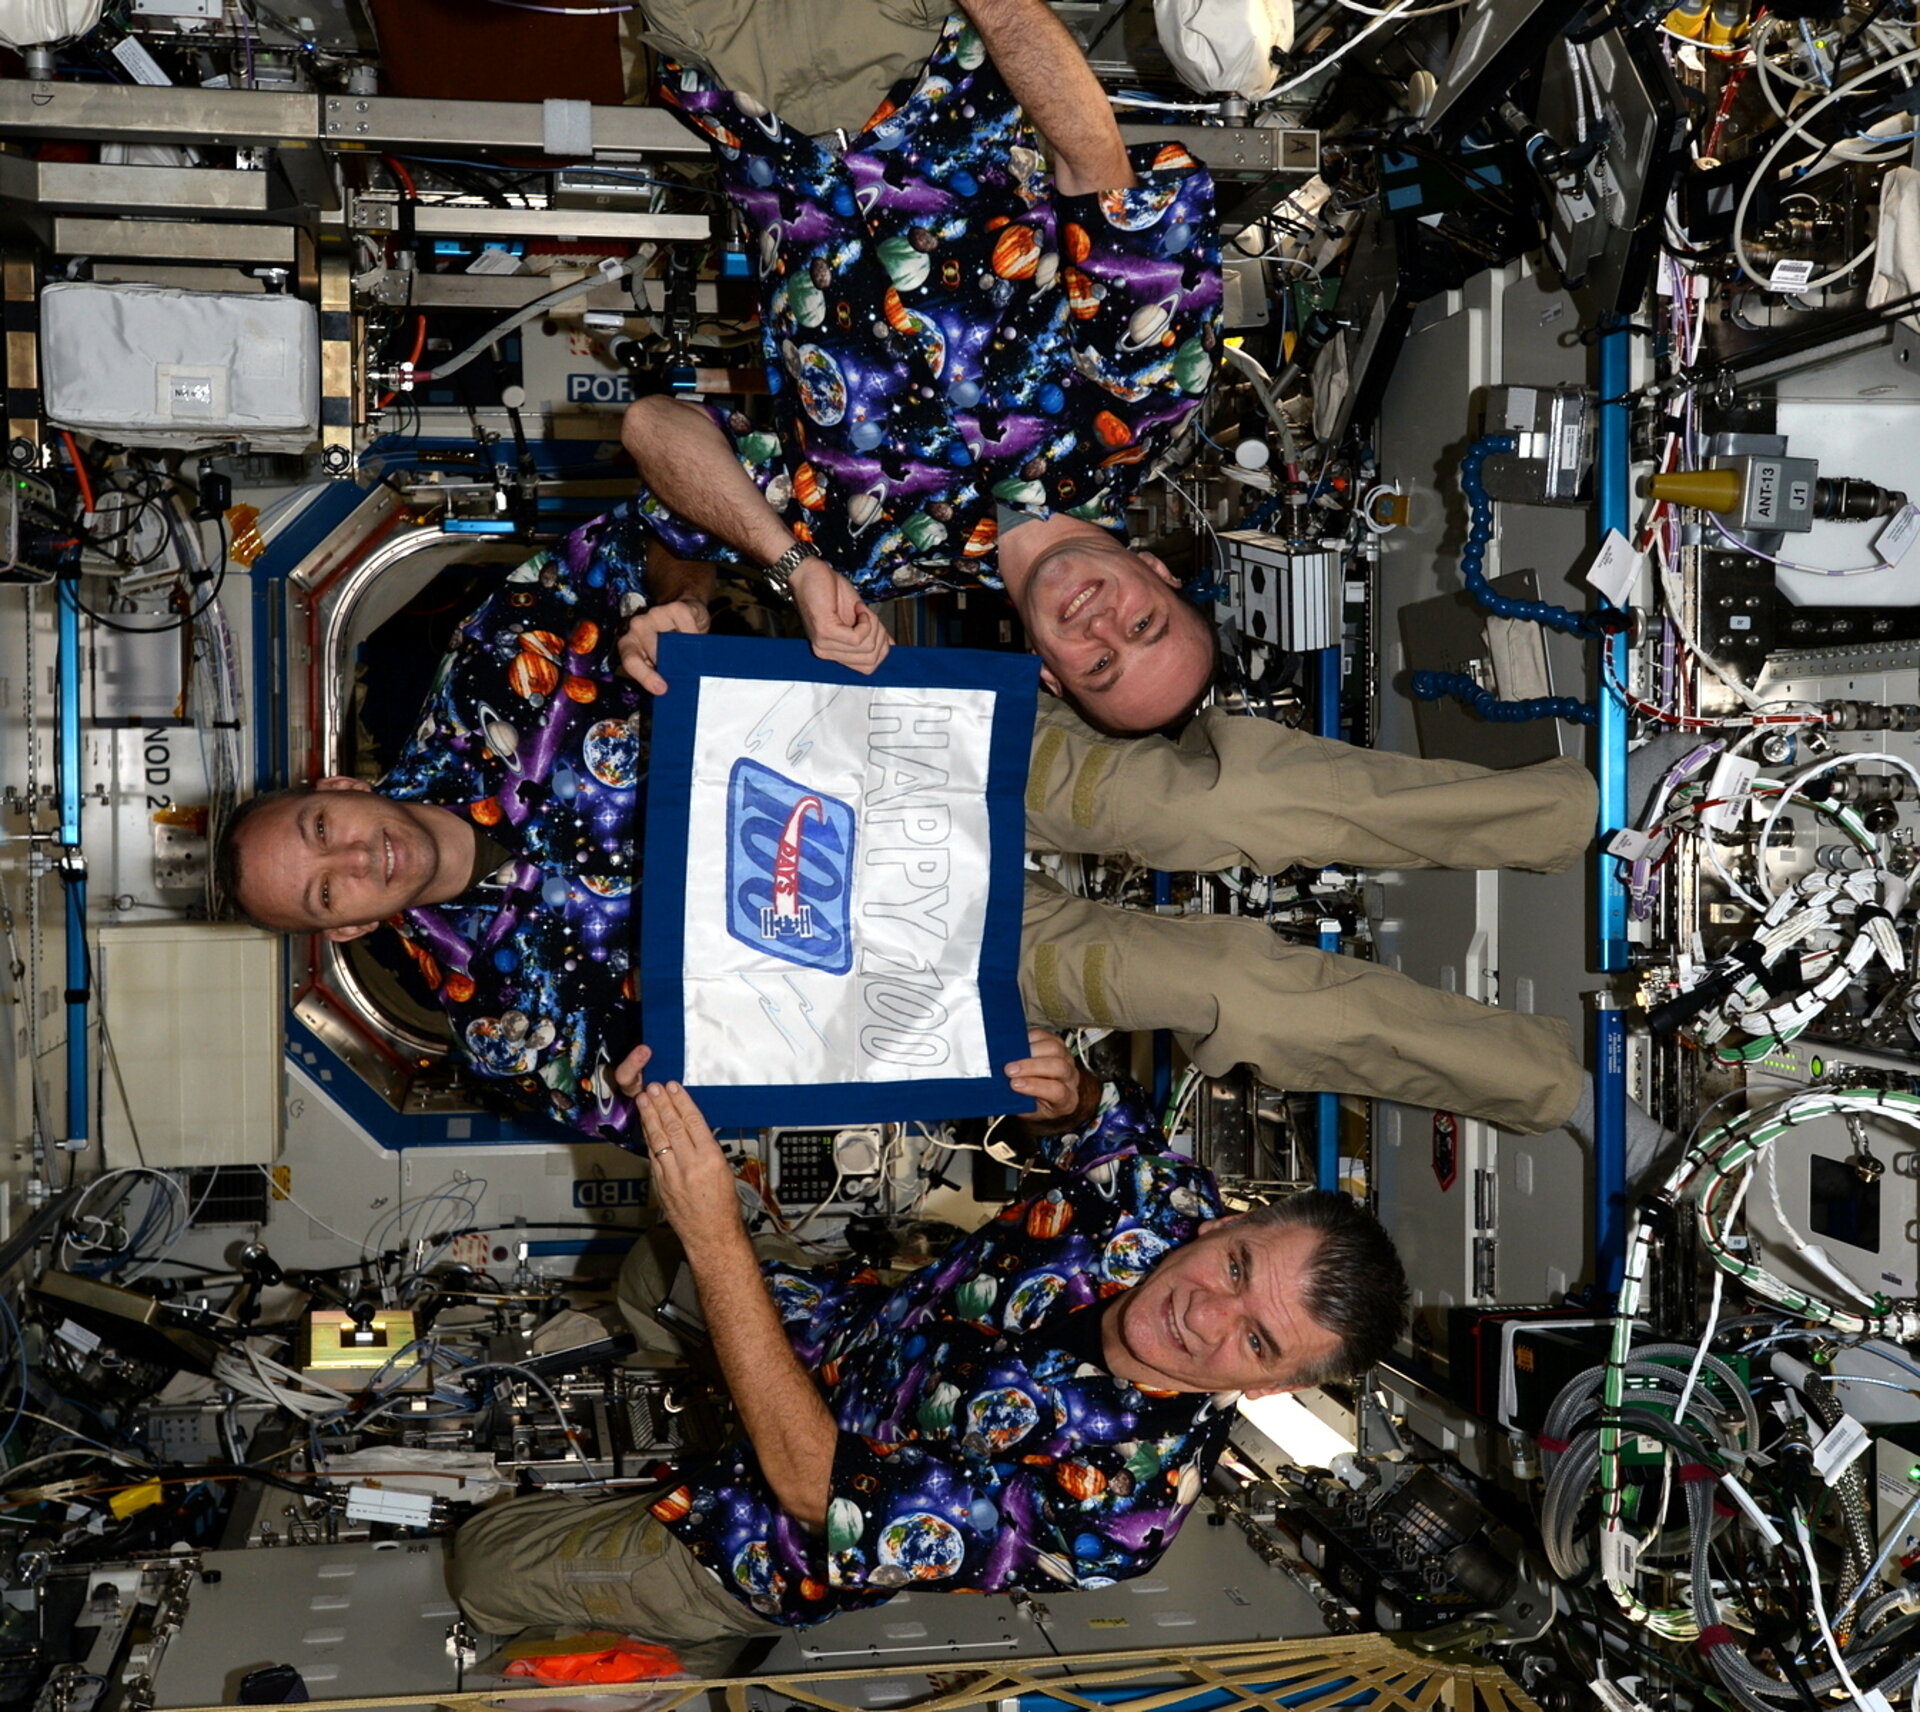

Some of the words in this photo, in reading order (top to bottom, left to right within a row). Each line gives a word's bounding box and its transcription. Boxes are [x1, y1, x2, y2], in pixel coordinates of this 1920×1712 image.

[572, 376, 636, 401] POR
[1758, 467, 1775, 517] ANT-13
[1793, 488, 1806, 505] J1
[147, 794, 171, 809] 2
[863, 702, 952, 940] HAPPY
[738, 776, 845, 957] 100
[775, 844, 799, 896] DAYS
[860, 946, 951, 1066] 100
